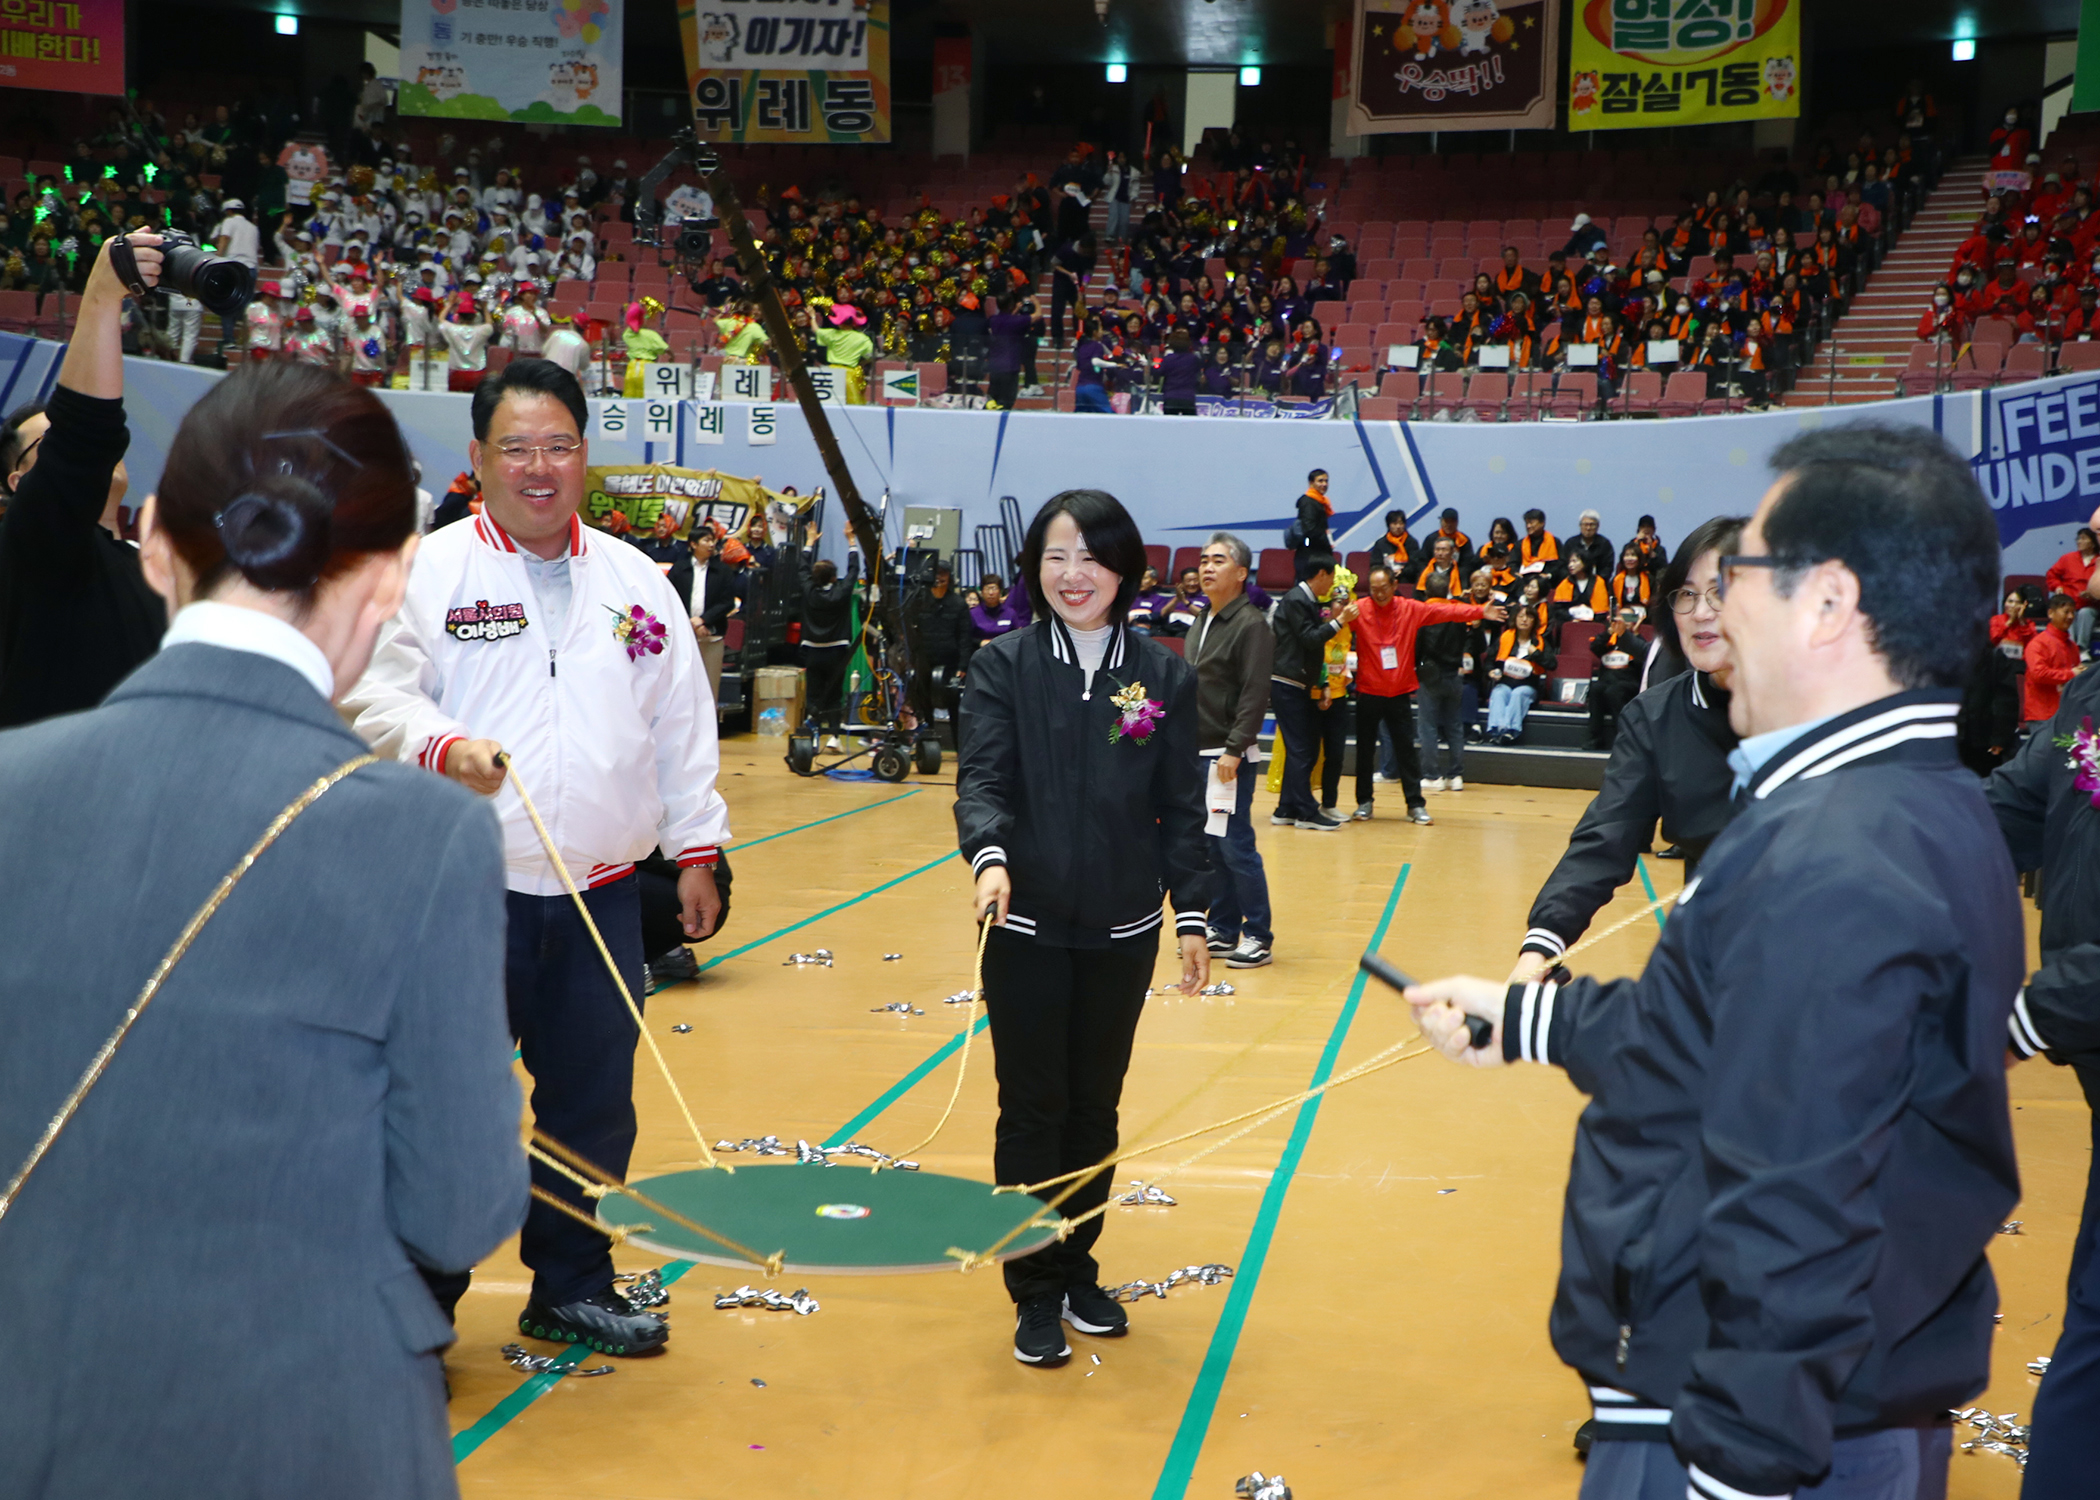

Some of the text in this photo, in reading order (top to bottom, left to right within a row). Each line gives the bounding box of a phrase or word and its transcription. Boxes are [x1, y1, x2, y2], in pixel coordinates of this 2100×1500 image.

[1, 0, 83, 29] 우리가
[1612, 0, 1755, 52] 열성!
[506, 34, 528, 47] 우승
[743, 17, 867, 57] 이기자!
[938, 65, 966, 90] 13
[1601, 62, 1760, 113] 잠실7동
[656, 367, 680, 395] 위
[735, 369, 758, 397] 례
[811, 371, 833, 400] 동
[603, 404, 775, 435] 승 위 례 동
[605, 474, 654, 494] 올해도
[1971, 448, 2100, 510] UNDE
[446, 603, 523, 622] 서울시의원
[456, 620, 520, 640] 이성배
